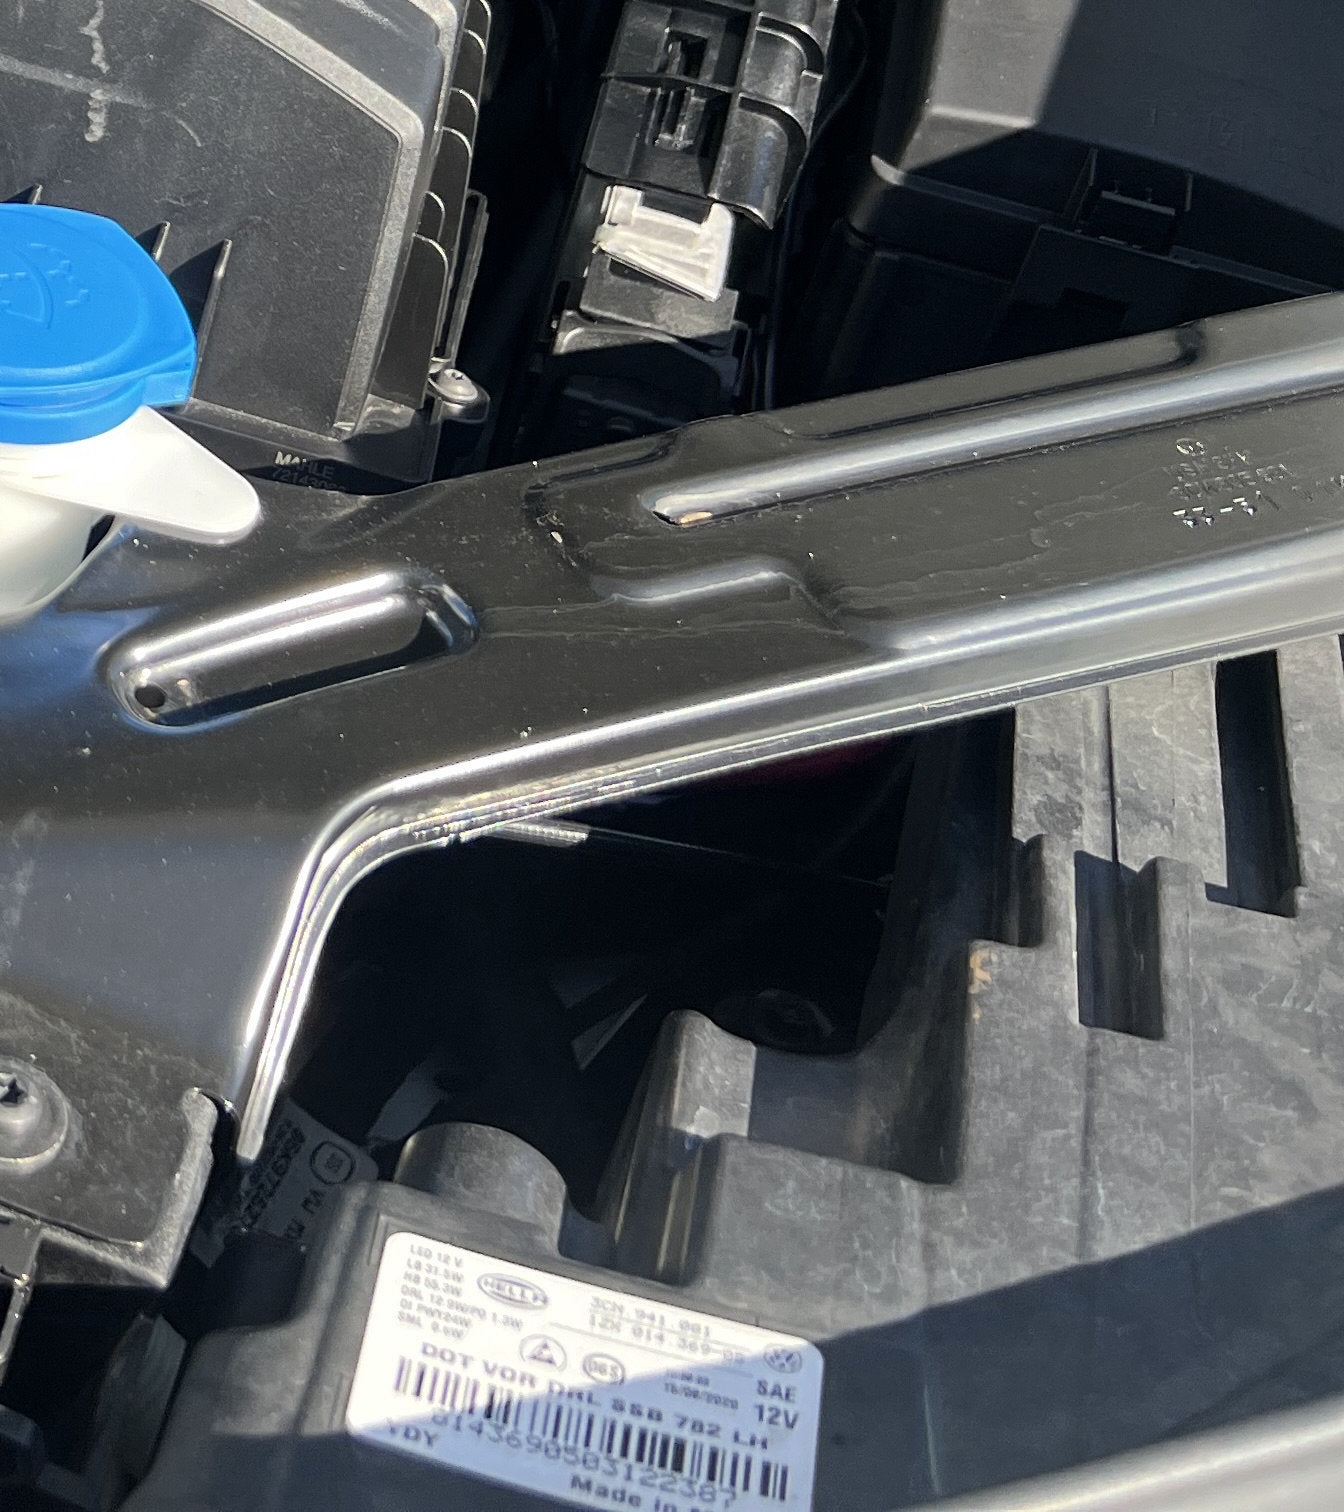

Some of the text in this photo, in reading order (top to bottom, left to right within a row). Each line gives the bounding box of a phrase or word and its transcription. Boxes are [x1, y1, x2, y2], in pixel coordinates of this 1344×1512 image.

[410, 1245, 462, 1266] LED 12 V
[756, 1377, 795, 1403] SAE
[753, 1401, 798, 1430] 12V
[570, 1473, 642, 1508] Made
